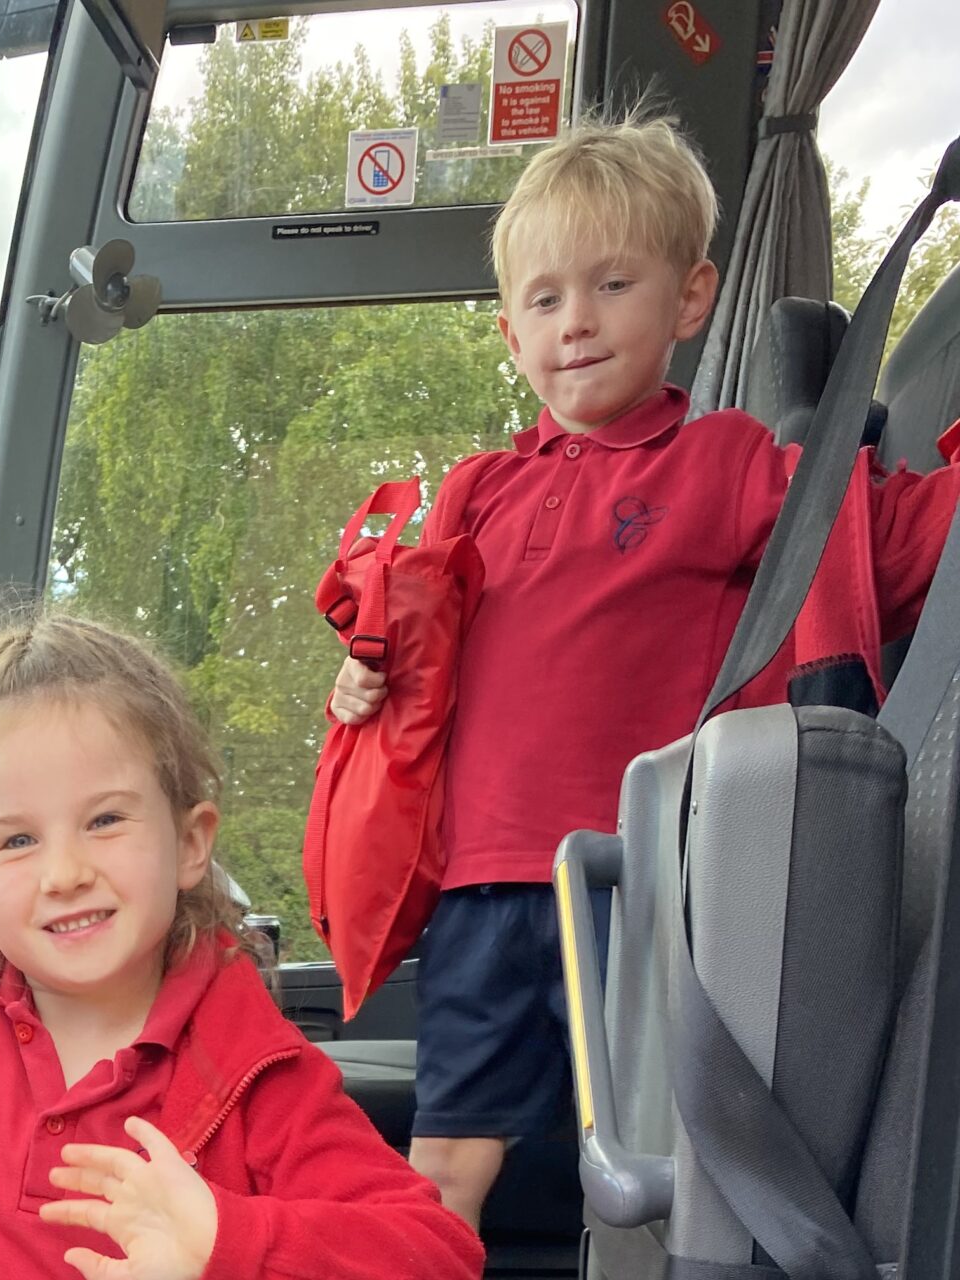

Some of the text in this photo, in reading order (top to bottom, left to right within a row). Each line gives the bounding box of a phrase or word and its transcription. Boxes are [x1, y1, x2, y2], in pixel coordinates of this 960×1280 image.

[499, 82, 555, 94] No smoking
[502, 96, 550, 106] It is against
[511, 107, 541, 116] the law
[501, 116, 550, 126] to smoke in
[501, 126, 548, 137] this vehicle
[276, 227, 299, 235] Please
[323, 225, 343, 234] speak
[353, 224, 373, 232] driver
